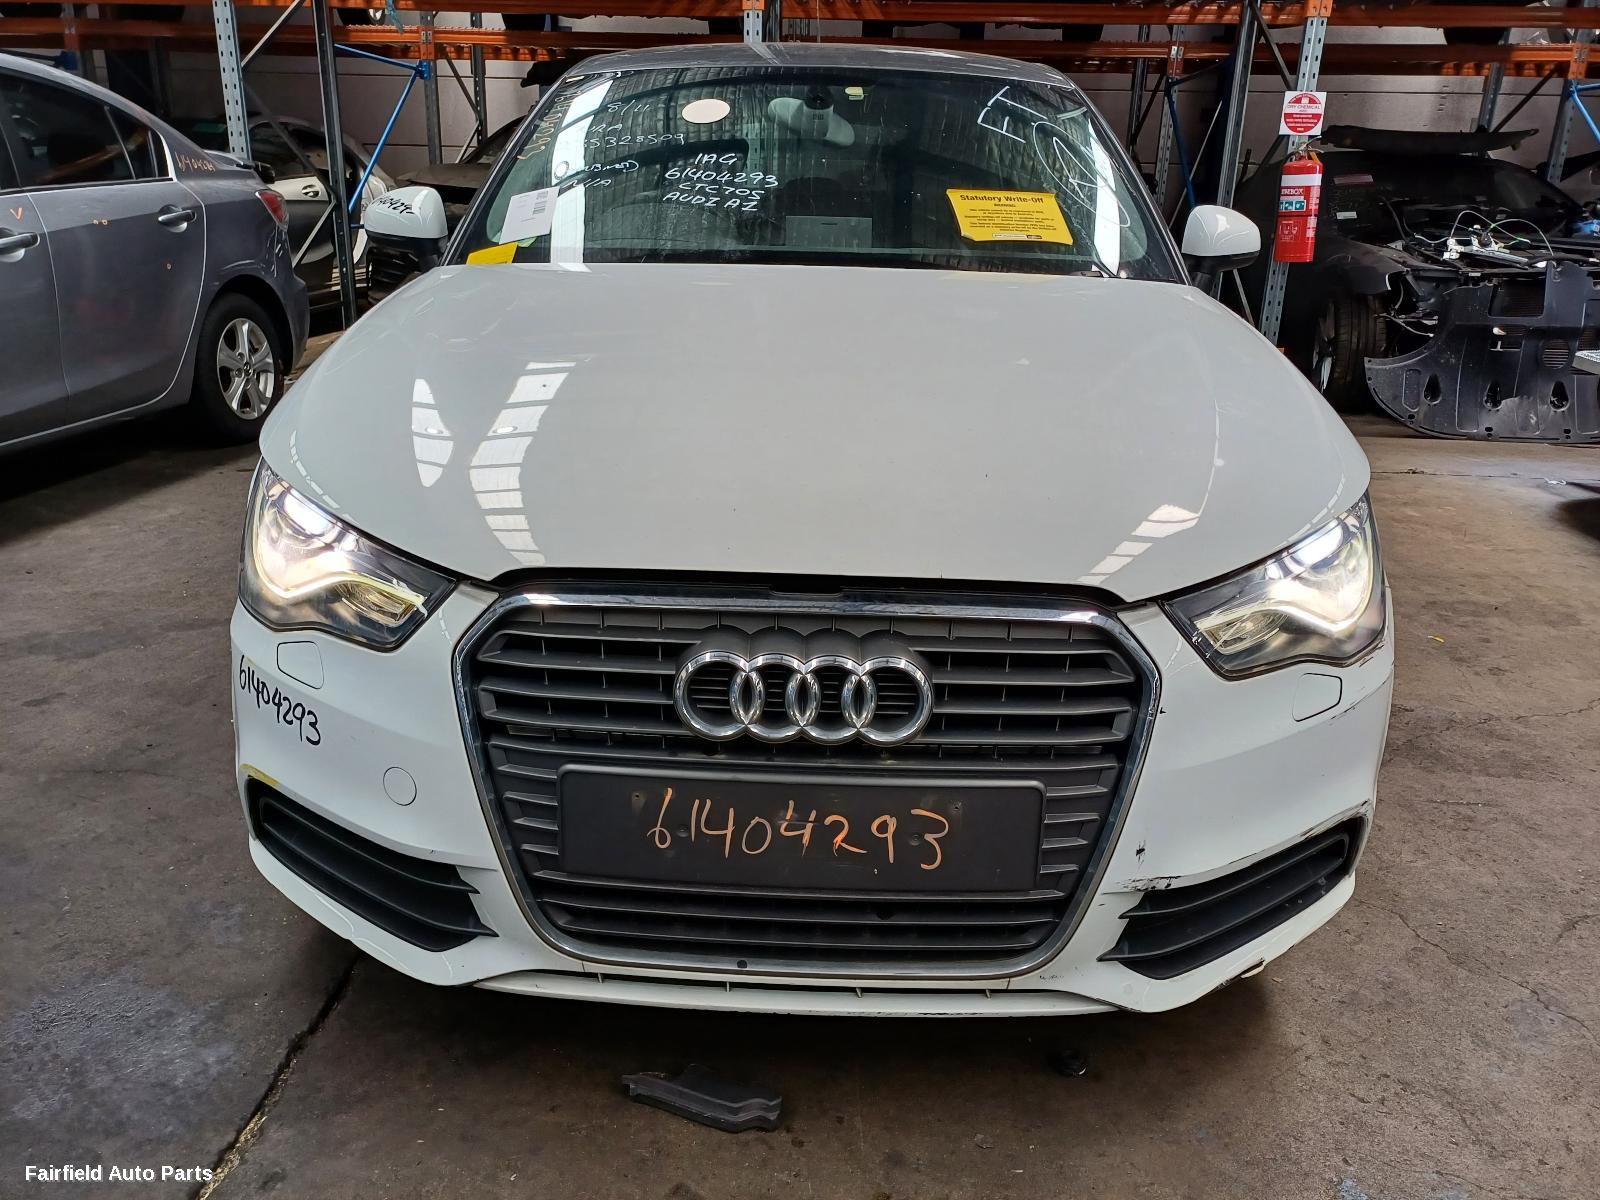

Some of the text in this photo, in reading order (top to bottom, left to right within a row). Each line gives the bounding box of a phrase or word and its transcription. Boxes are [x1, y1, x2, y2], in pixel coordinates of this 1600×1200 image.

[664, 167, 779, 188] 61404293
[960, 194, 1044, 204] Statutory Write-Off
[239, 654, 321, 746] 61404293
[646, 787, 950, 870] 61404293
